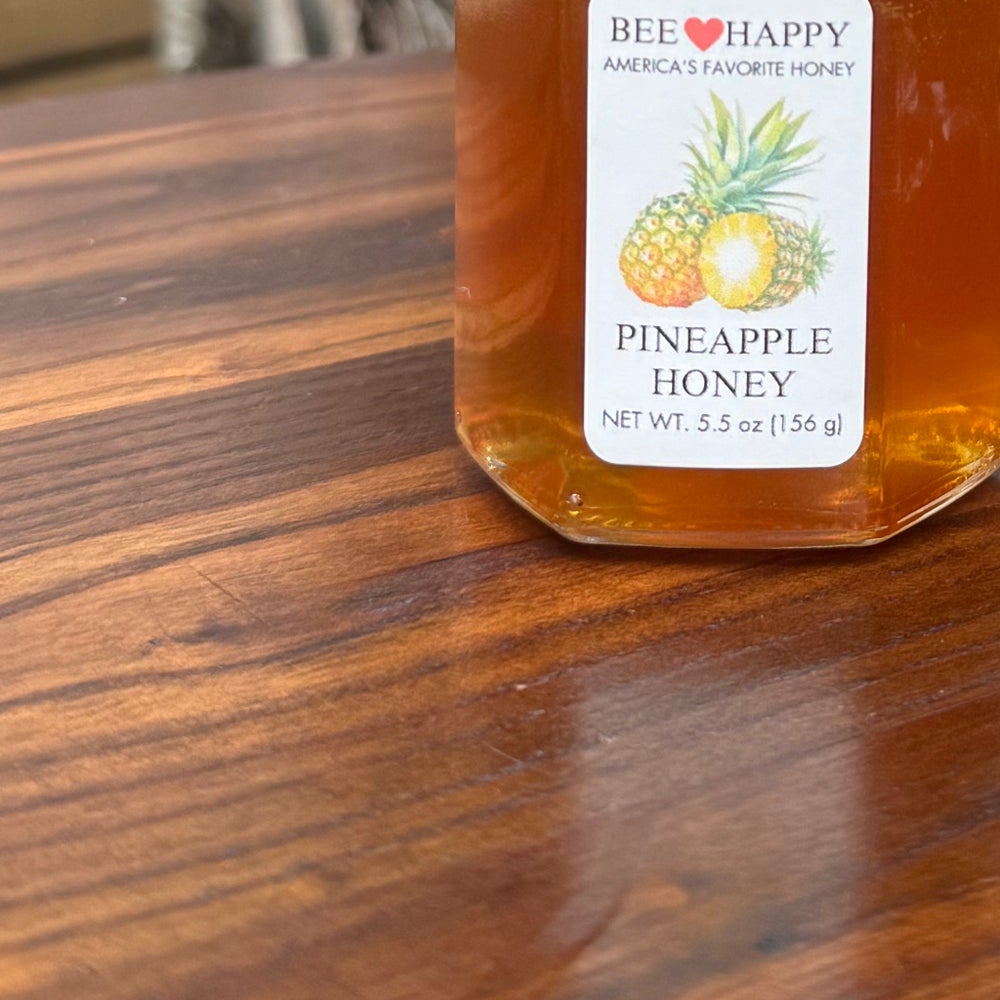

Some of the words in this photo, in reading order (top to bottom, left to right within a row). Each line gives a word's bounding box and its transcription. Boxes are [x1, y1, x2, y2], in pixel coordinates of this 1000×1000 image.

[611, 16, 679, 45] BEE
[727, 20, 851, 48] HAPPY
[603, 56, 698, 75] AMERICA'S
[704, 59, 785, 77] FAVORITE
[791, 61, 856, 77] HONEY
[616, 323, 834, 355] PINEAPPLE
[652, 368, 797, 398] HONEY
[603, 409, 642, 430] NET
[649, 411, 689, 432] WT.
[697, 413, 731, 433] 5.5
[739, 417, 763, 433] oz
[771, 412, 817, 437] (156
[824, 412, 842, 437] g)
